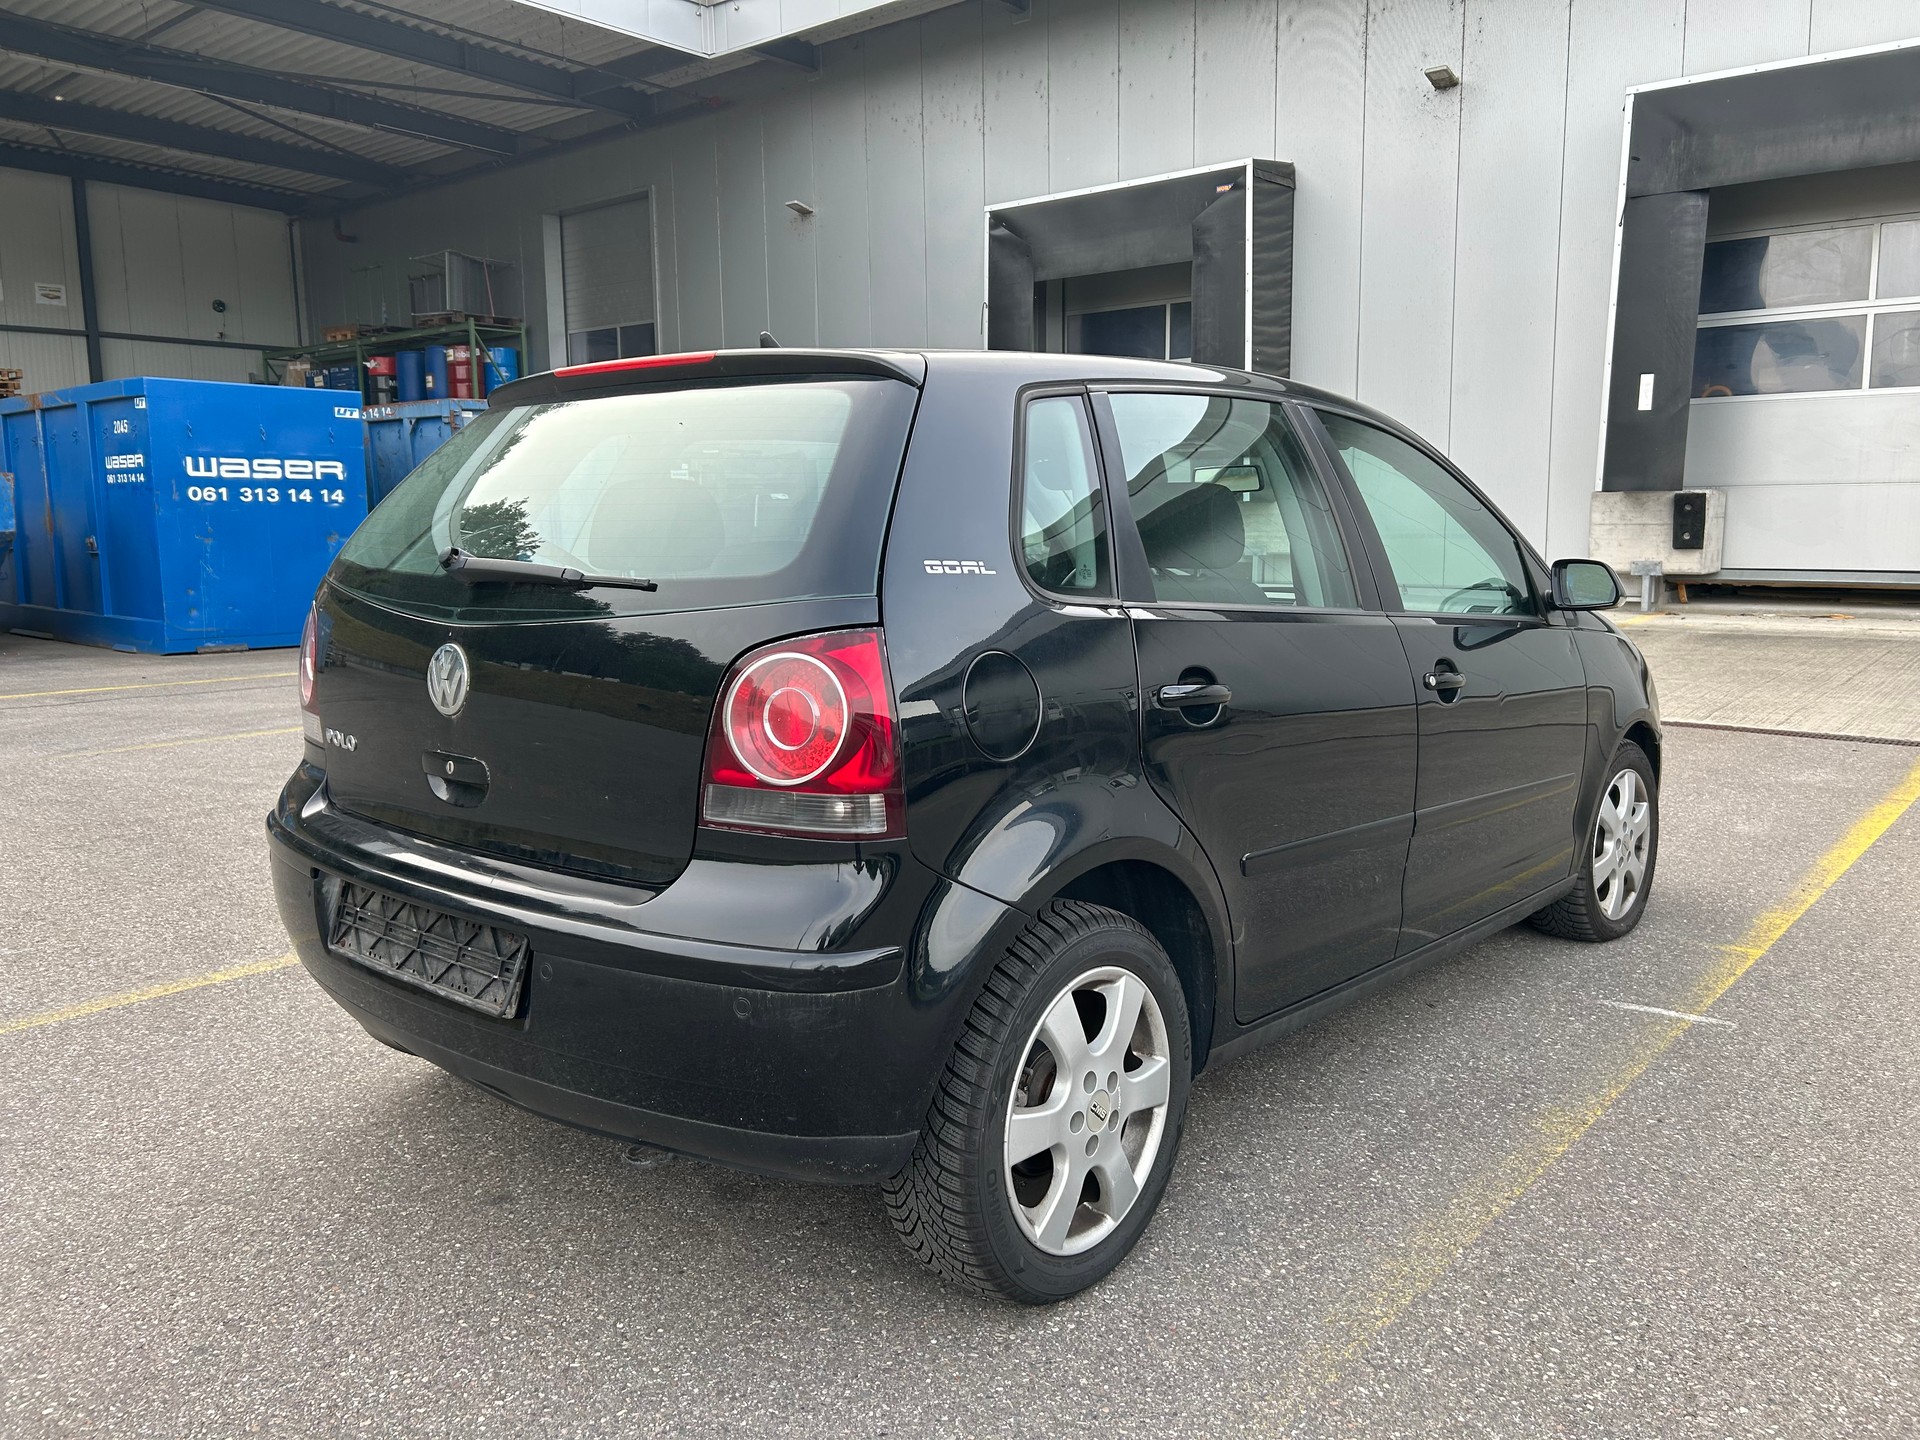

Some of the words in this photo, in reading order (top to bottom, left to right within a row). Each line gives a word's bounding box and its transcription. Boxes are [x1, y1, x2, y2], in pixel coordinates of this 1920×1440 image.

[368, 407, 379, 418] 14
[113, 420, 128, 434] 2045
[107, 474, 116, 484] 061
[117, 474, 128, 483] 313
[128, 474, 136, 483] 14
[137, 473, 145, 483] 14
[187, 486, 228, 502] 061
[239, 488, 280, 502] 313
[287, 489, 313, 503] 14
[320, 489, 345, 503] 14
[923, 559, 997, 575] GOAL
[325, 727, 358, 752] POLO
[1090, 1100, 1107, 1121] CMS
